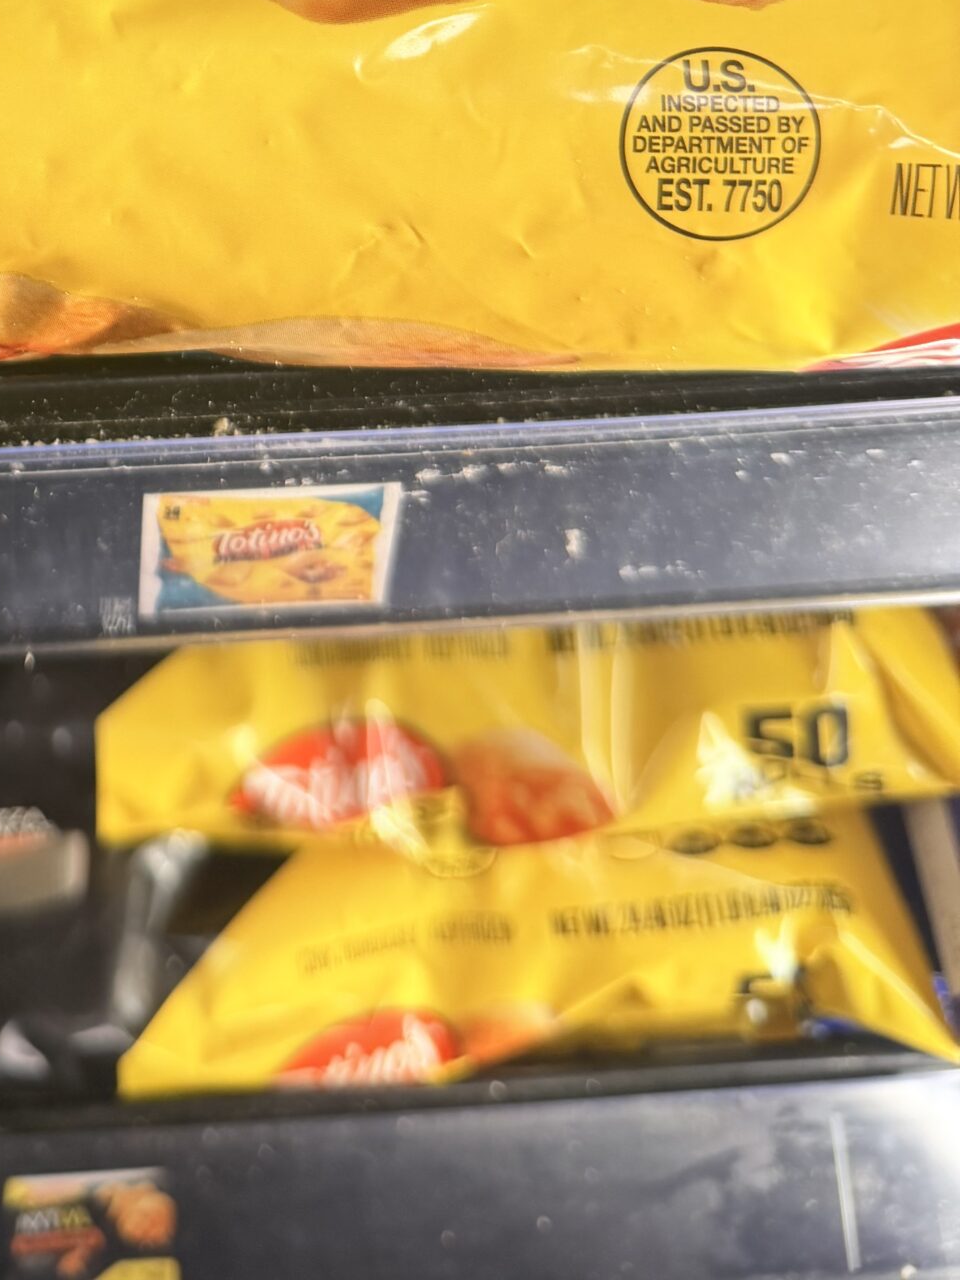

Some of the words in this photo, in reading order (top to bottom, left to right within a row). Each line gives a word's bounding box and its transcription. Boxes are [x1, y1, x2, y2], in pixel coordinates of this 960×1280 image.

[681, 58, 756, 93] U.S.
[660, 94, 781, 114] INSPECTED
[636, 115, 683, 134] AND
[688, 115, 771, 135] PASSED
[777, 115, 805, 134] BY
[632, 135, 775, 155] DEPARTMENT
[780, 135, 809, 155] OF
[645, 156, 795, 175] AGRICULTURE
[656, 177, 713, 213] EST.
[723, 179, 784, 213] 7750
[890, 161, 943, 219] NET
